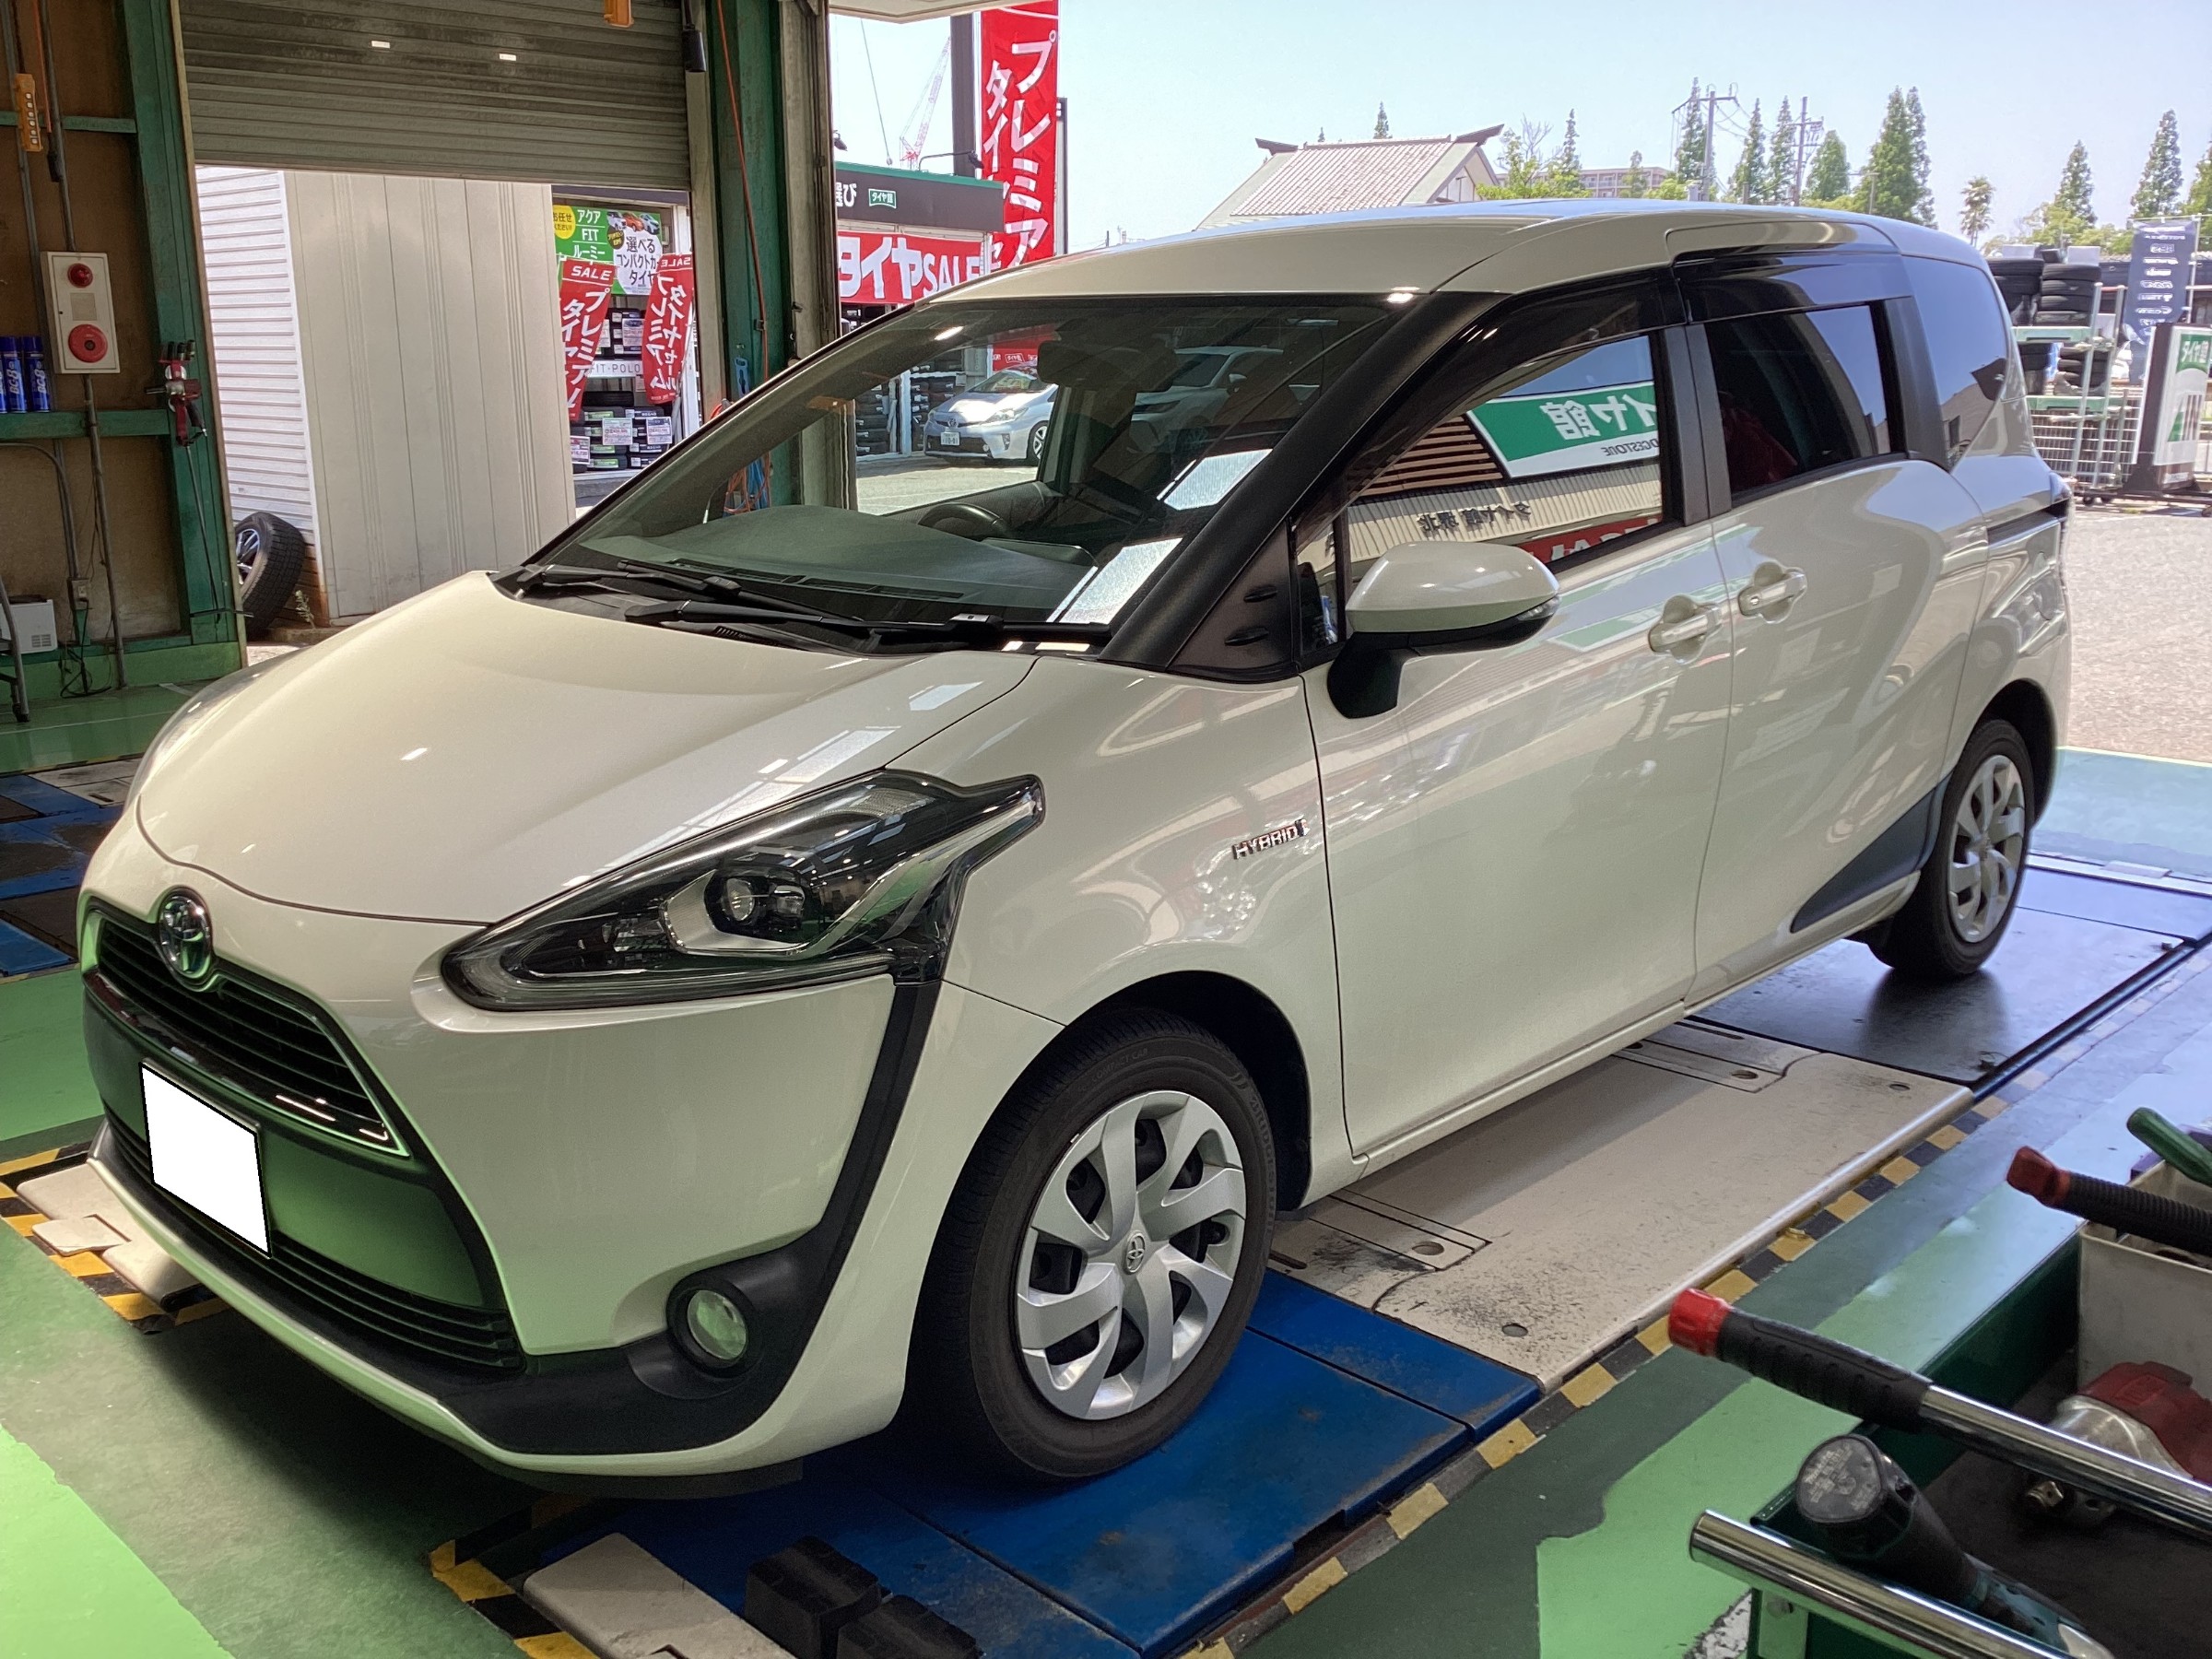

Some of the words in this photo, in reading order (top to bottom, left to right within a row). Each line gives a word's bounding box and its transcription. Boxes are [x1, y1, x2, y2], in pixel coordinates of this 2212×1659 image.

[577, 209, 601, 224] アクア
[582, 228, 599, 241] FIT
[573, 244, 606, 259] ルーミー
[626, 236, 655, 253] 選べる
[617, 253, 659, 269] コンパクトカ
[571, 265, 612, 280] SALE
[1231, 824, 1299, 860] HYBRID
